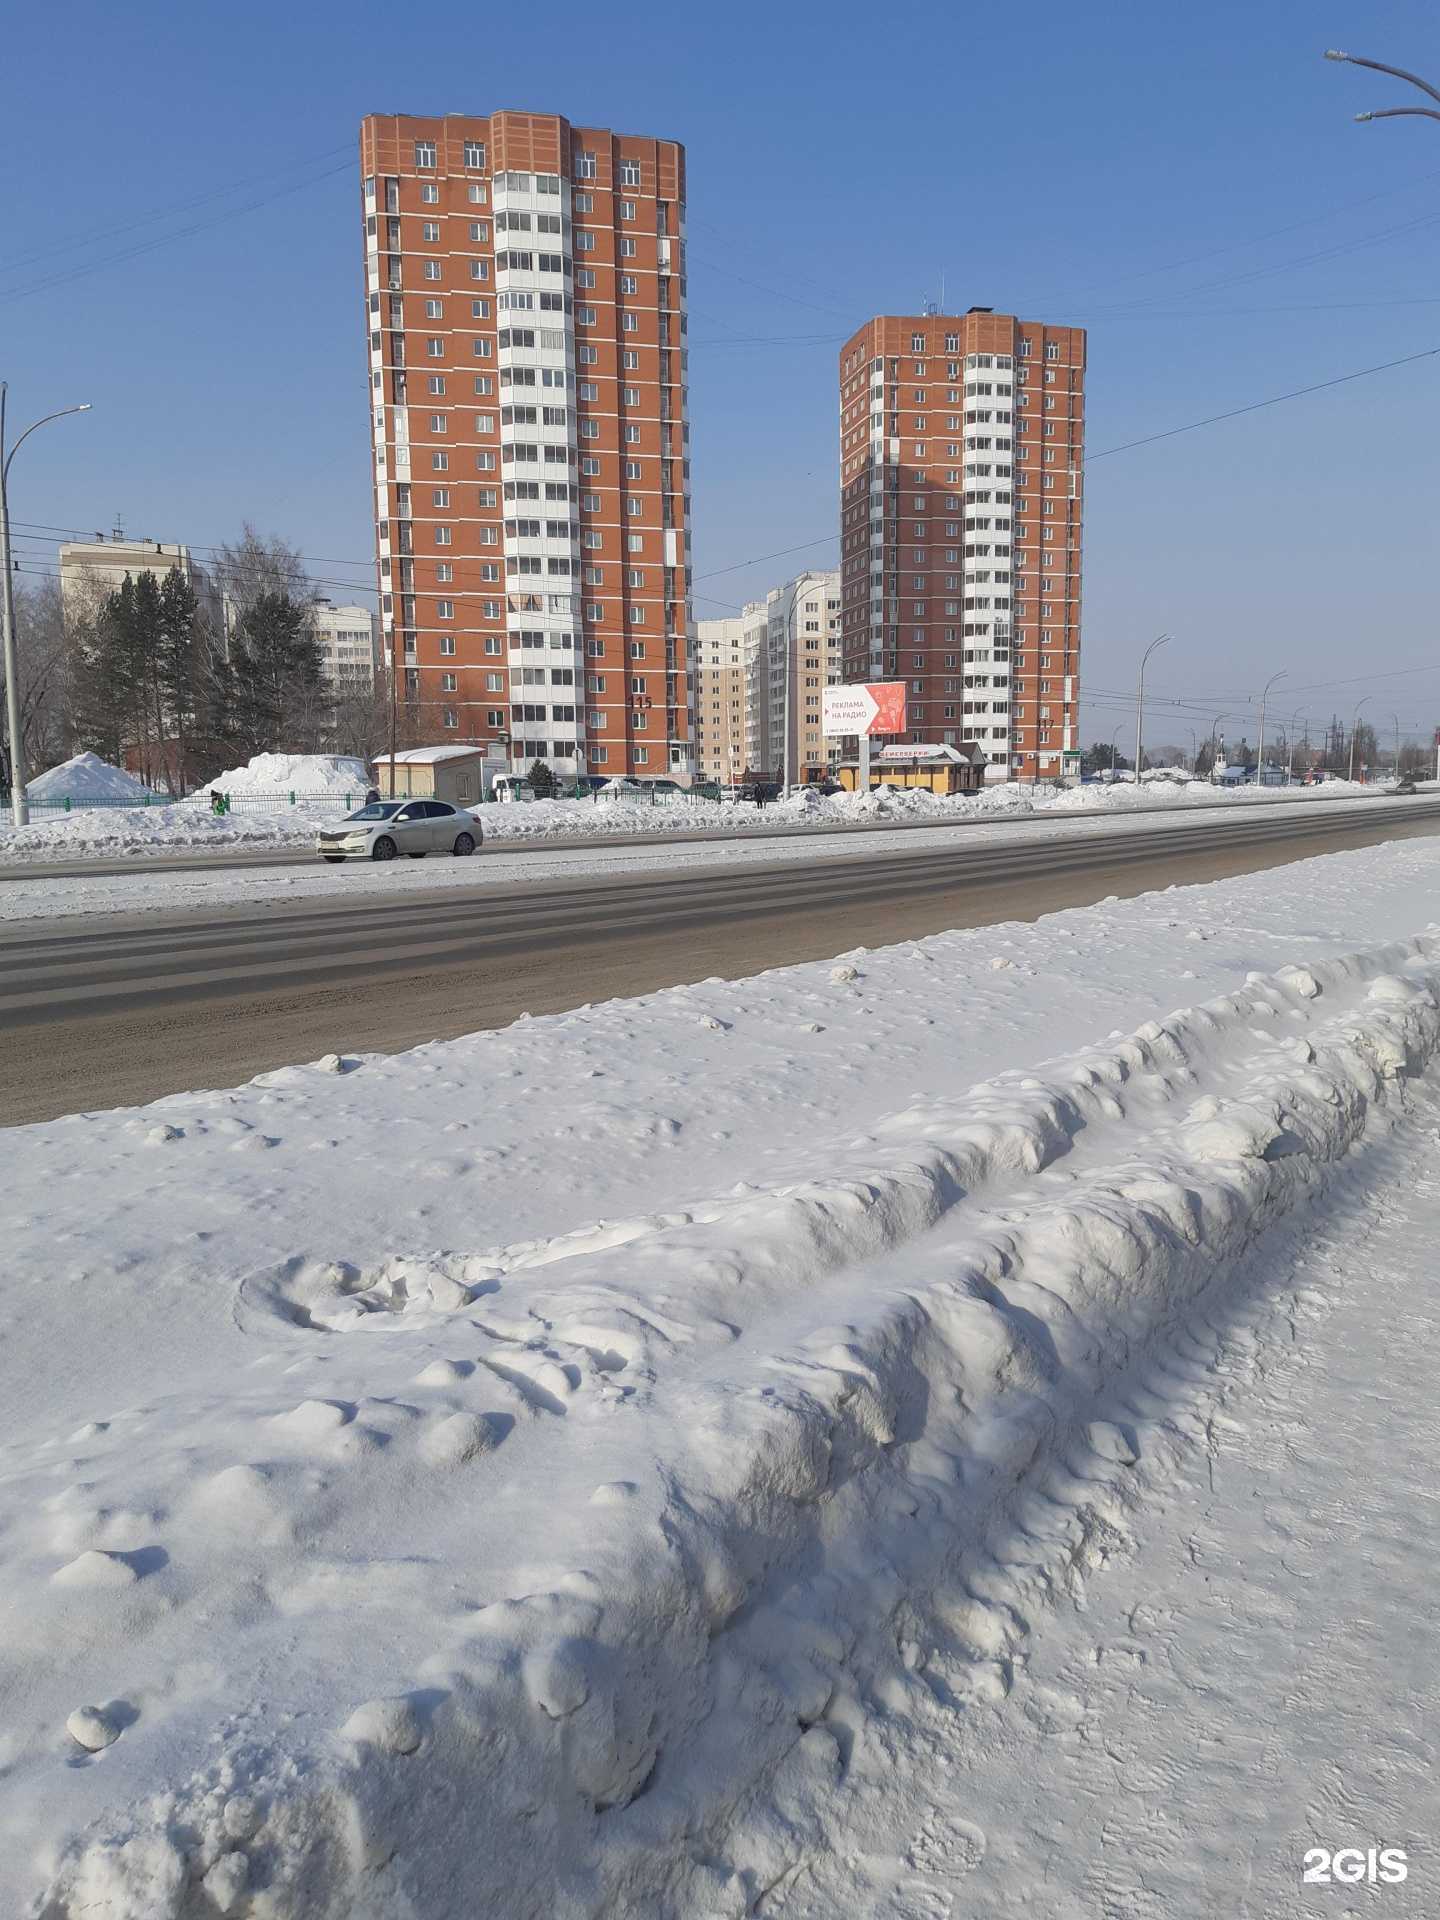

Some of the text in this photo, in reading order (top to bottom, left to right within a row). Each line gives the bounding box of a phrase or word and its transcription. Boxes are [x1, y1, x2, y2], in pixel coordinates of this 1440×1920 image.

[628, 696, 652, 709] 115
[831, 701, 864, 709] РЕКЛАМА
[843, 711, 867, 719] РАДИО
